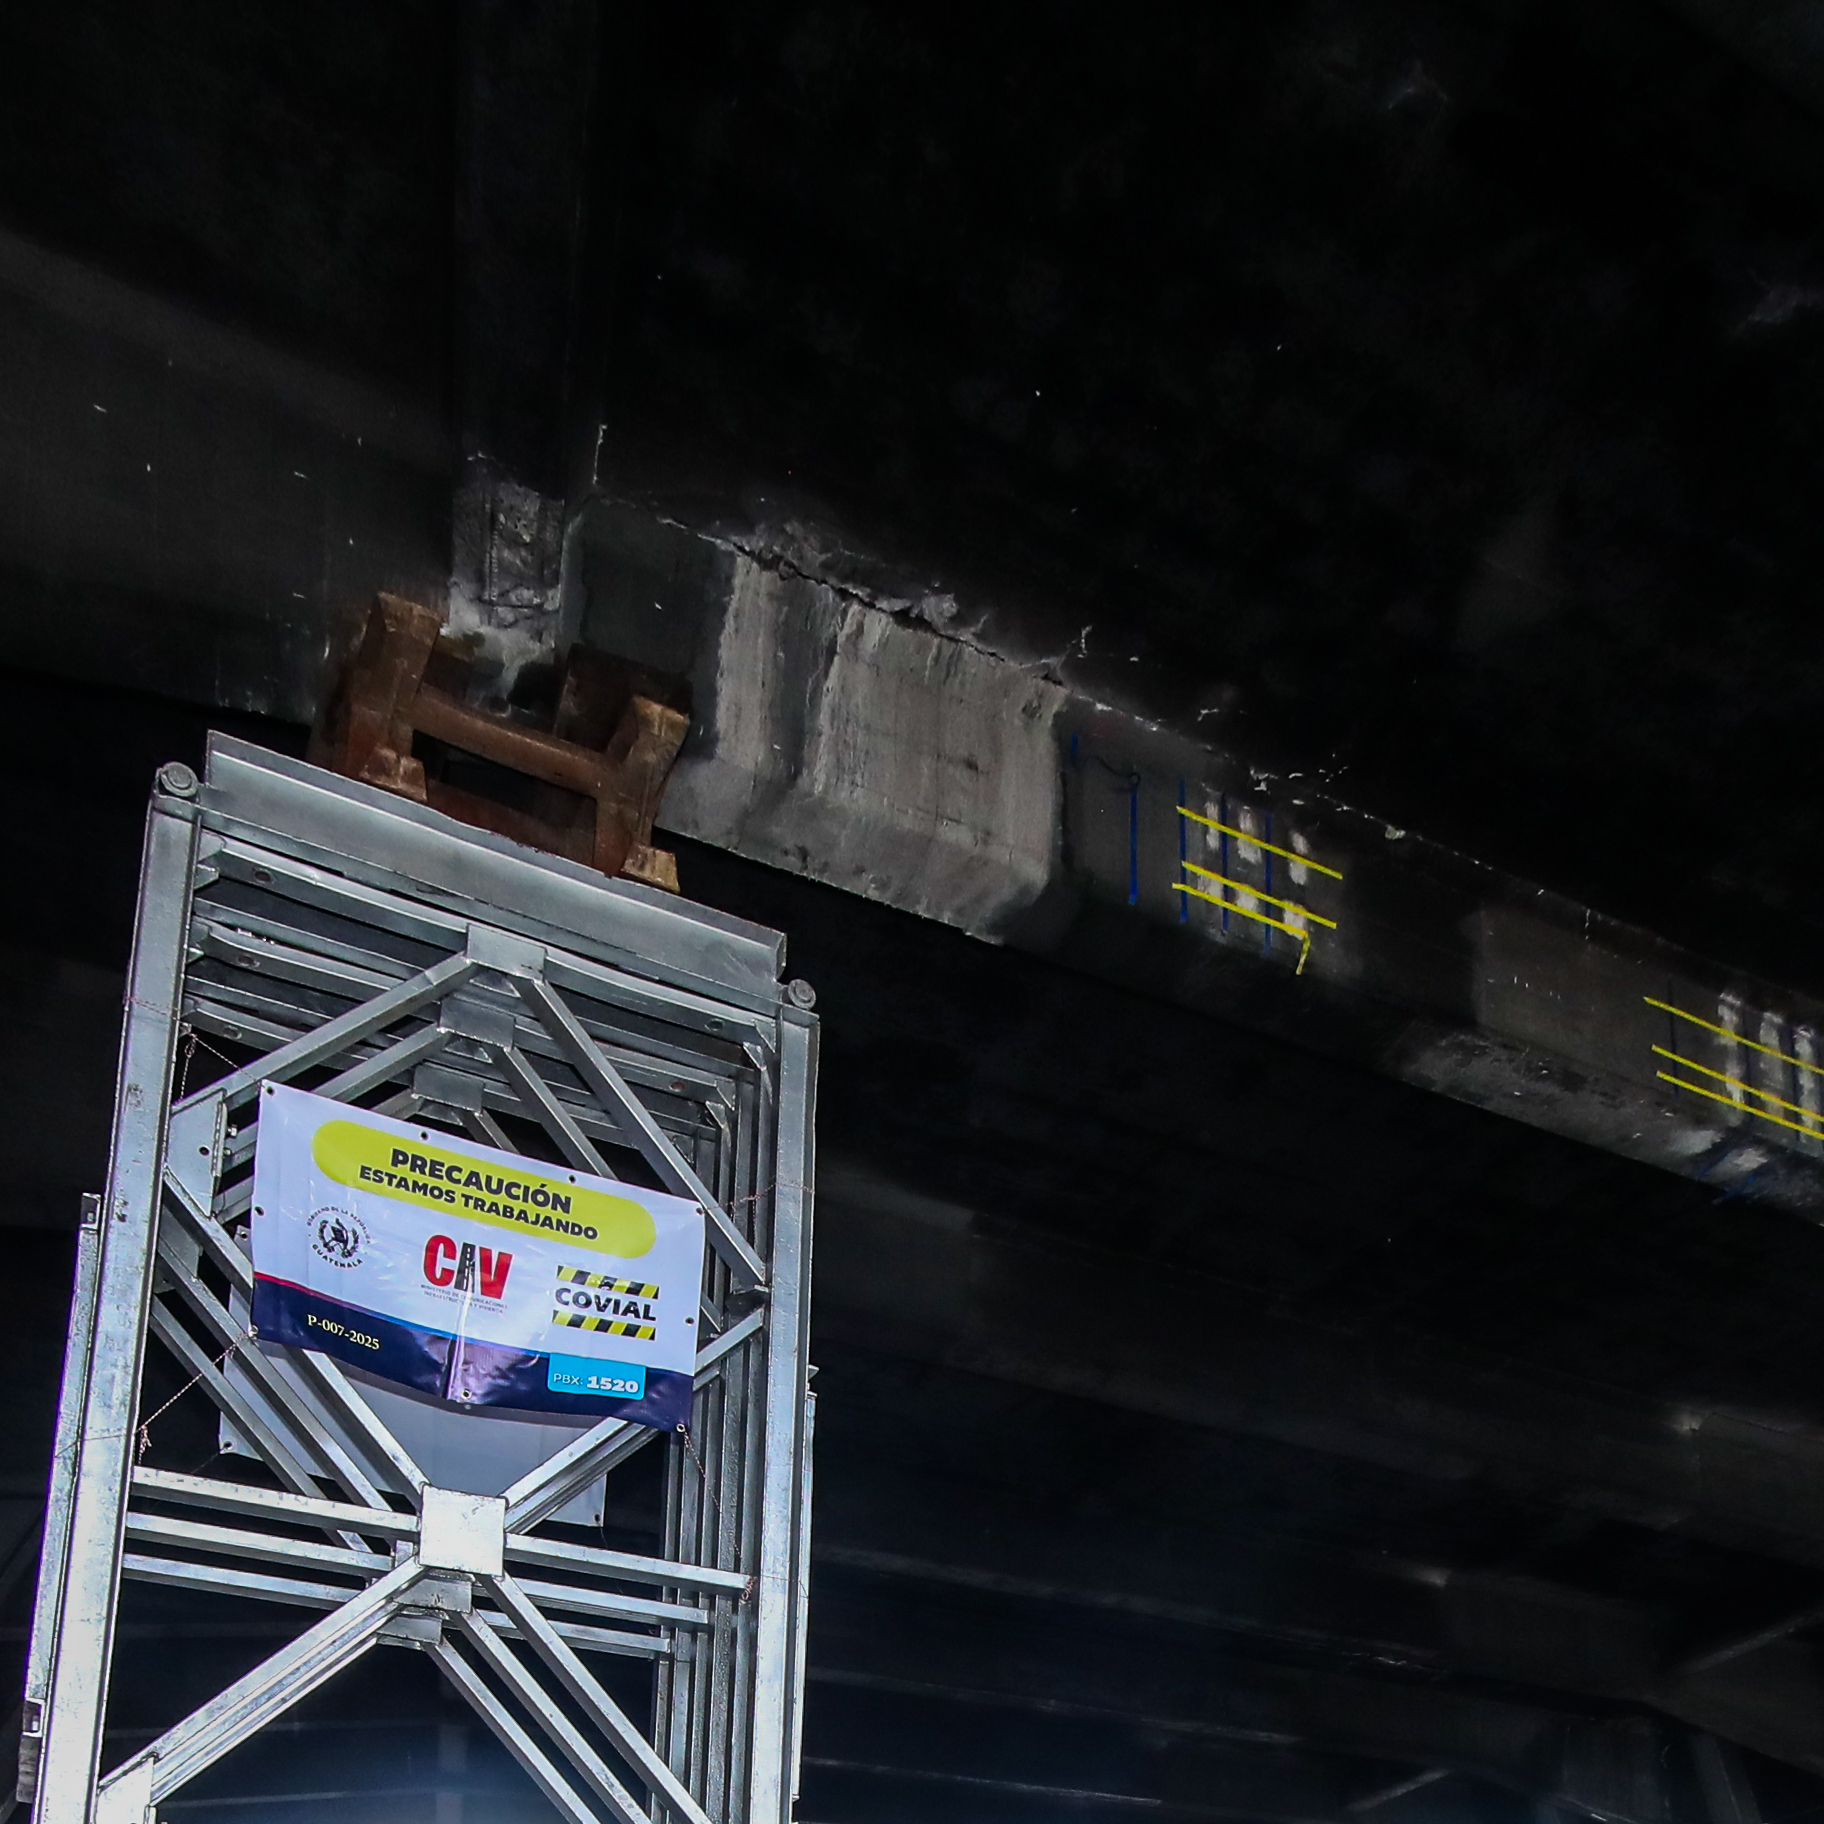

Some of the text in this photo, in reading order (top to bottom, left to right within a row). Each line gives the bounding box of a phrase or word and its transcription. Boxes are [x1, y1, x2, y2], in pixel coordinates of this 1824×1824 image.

[390, 1148, 572, 1215] PRECAUCIÓN
[359, 1164, 599, 1240] ESTAMOS TRABAJANDO
[312, 1244, 363, 1268] GUATEMALA
[422, 1234, 513, 1300] CIV
[555, 1287, 657, 1322] COVIAL
[307, 1313, 381, 1350] P-007-2025
[553, 1372, 639, 1393] PBX: 1520
